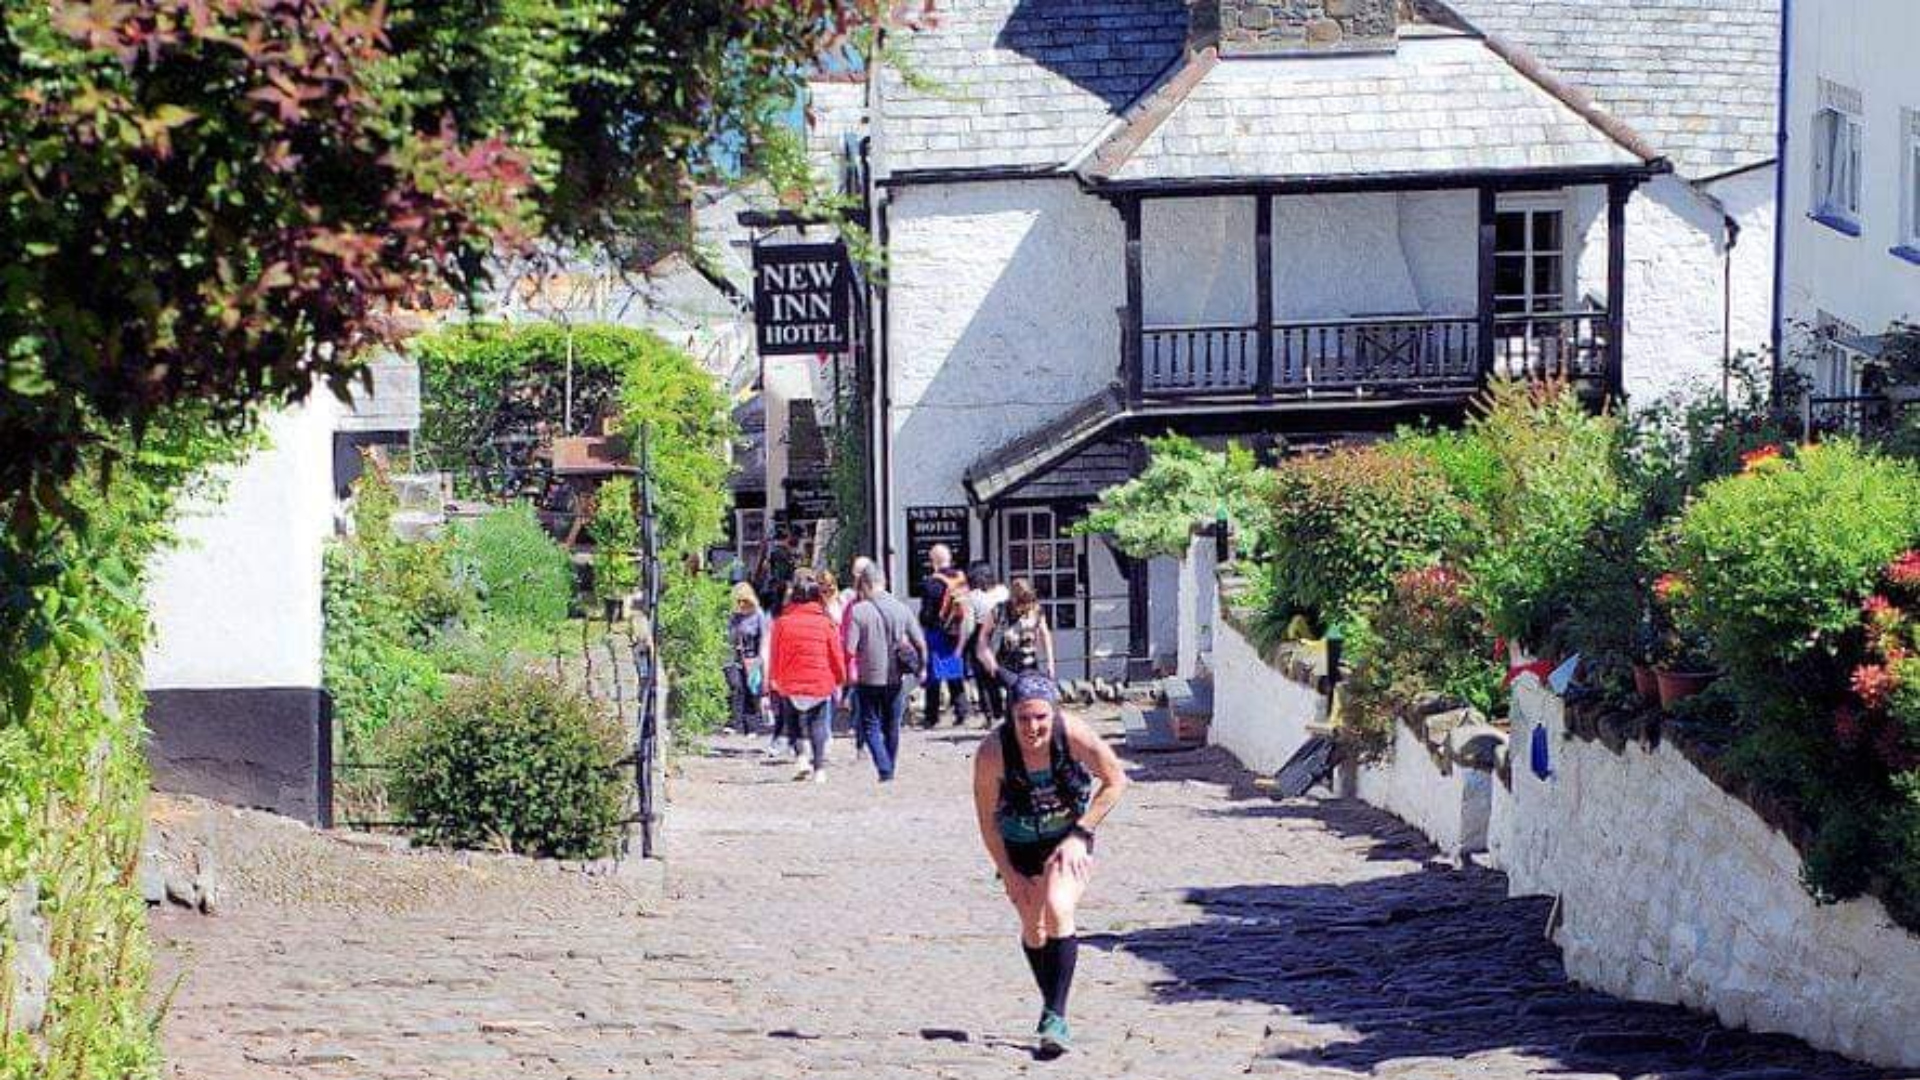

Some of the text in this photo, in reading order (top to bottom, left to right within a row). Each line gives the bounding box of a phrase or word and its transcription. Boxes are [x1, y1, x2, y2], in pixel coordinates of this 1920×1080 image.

[763, 261, 838, 290] NEW
[772, 293, 831, 321] INN
[765, 323, 843, 344] HOTEL
